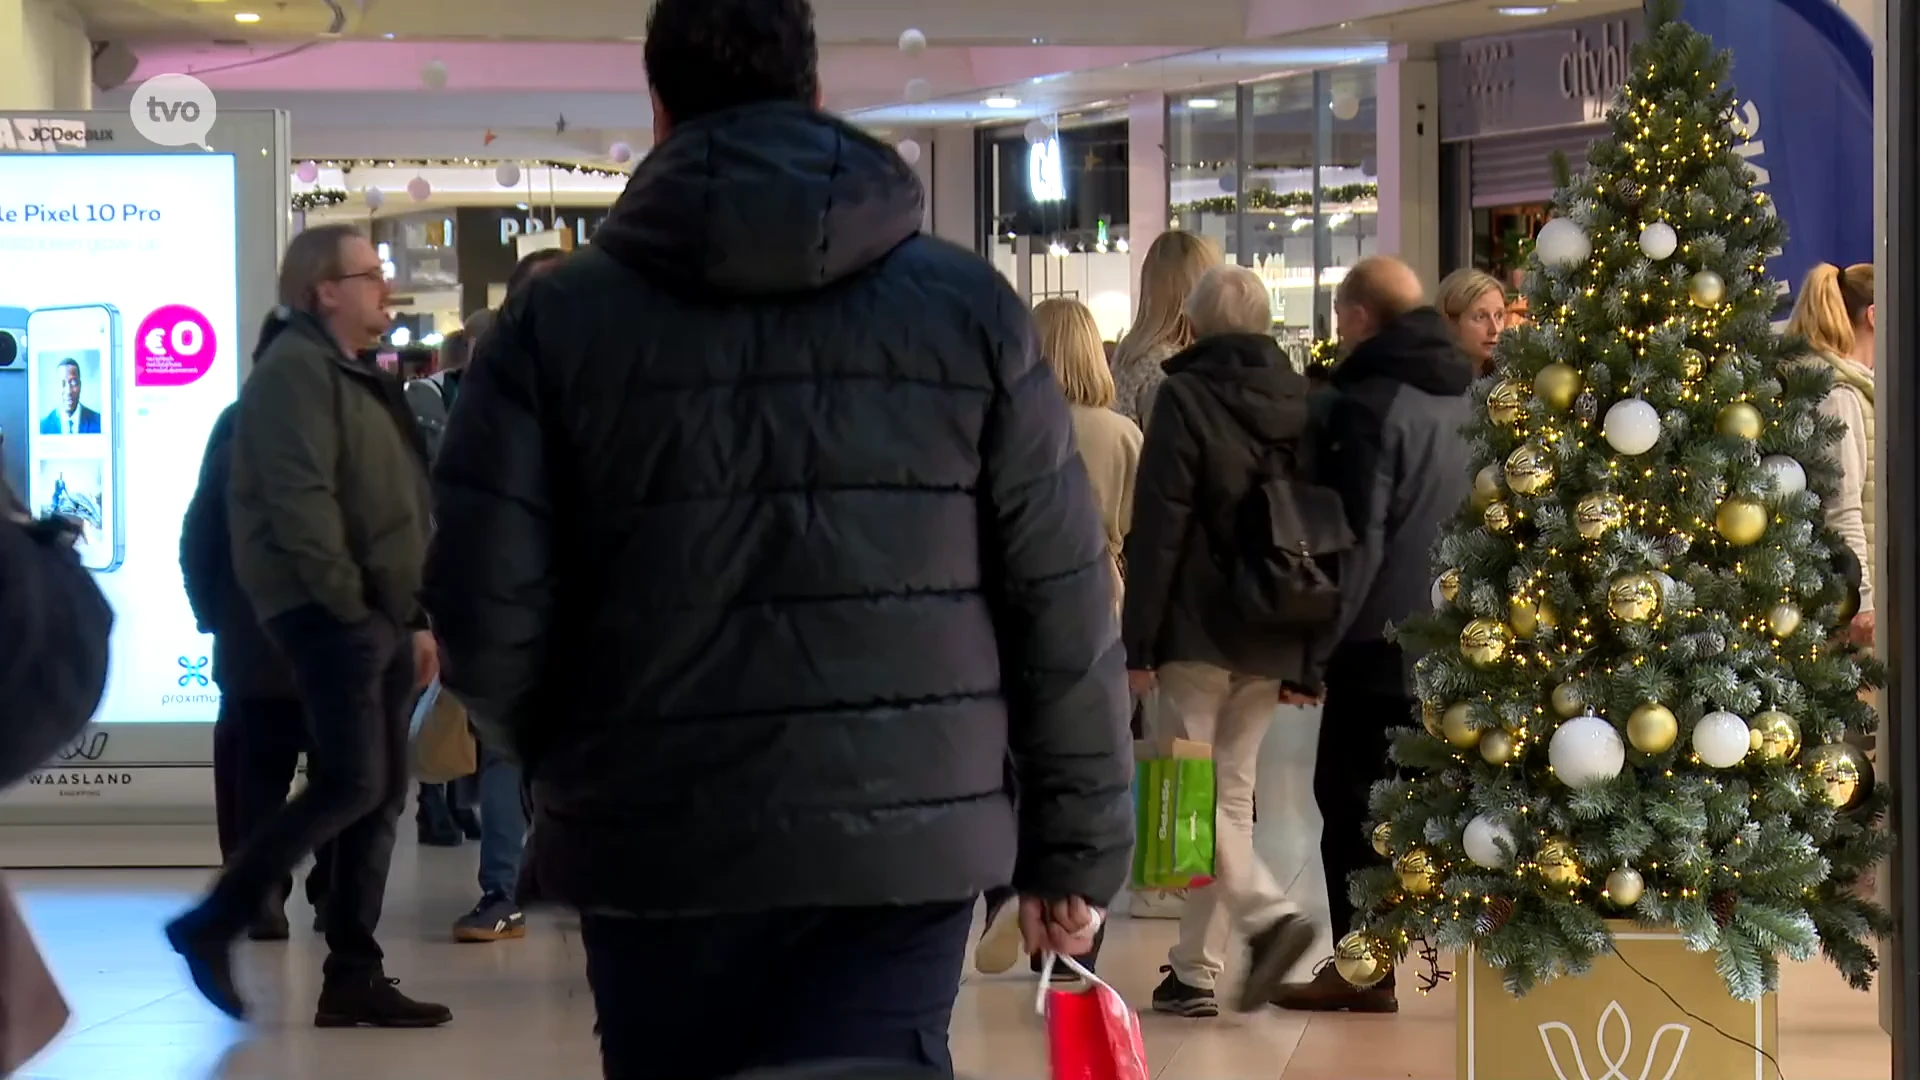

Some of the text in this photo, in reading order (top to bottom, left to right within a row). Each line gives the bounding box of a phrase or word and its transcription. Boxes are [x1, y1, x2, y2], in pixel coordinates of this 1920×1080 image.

[1559, 19, 1632, 118] citybl
[25, 203, 79, 222] Pixel
[86, 203, 115, 222] 10
[123, 203, 161, 222] Pro
[29, 773, 132, 785] WAASLAND
